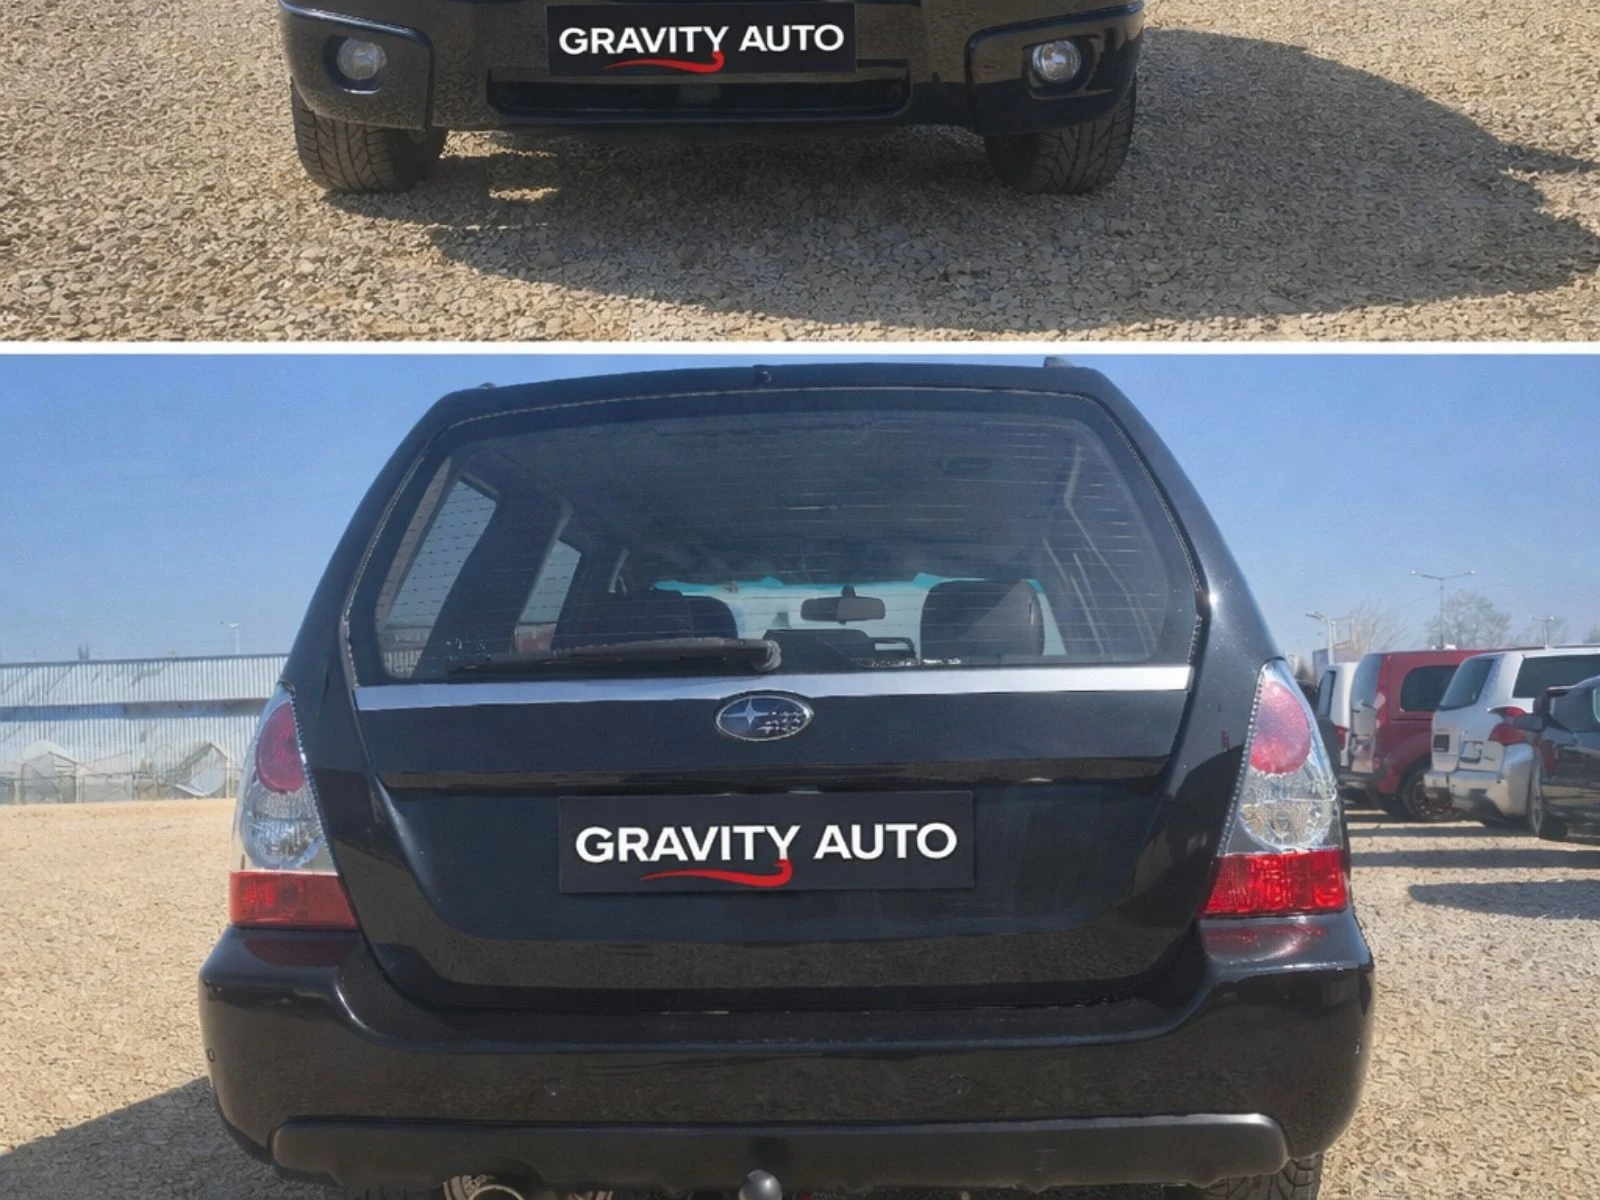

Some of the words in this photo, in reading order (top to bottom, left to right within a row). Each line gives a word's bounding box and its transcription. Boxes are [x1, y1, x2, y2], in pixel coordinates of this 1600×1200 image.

[558, 25, 729, 73] GRAVITY
[738, 23, 845, 52] AUTO
[575, 825, 801, 887] GRAVITY
[813, 822, 958, 860] AUTO
